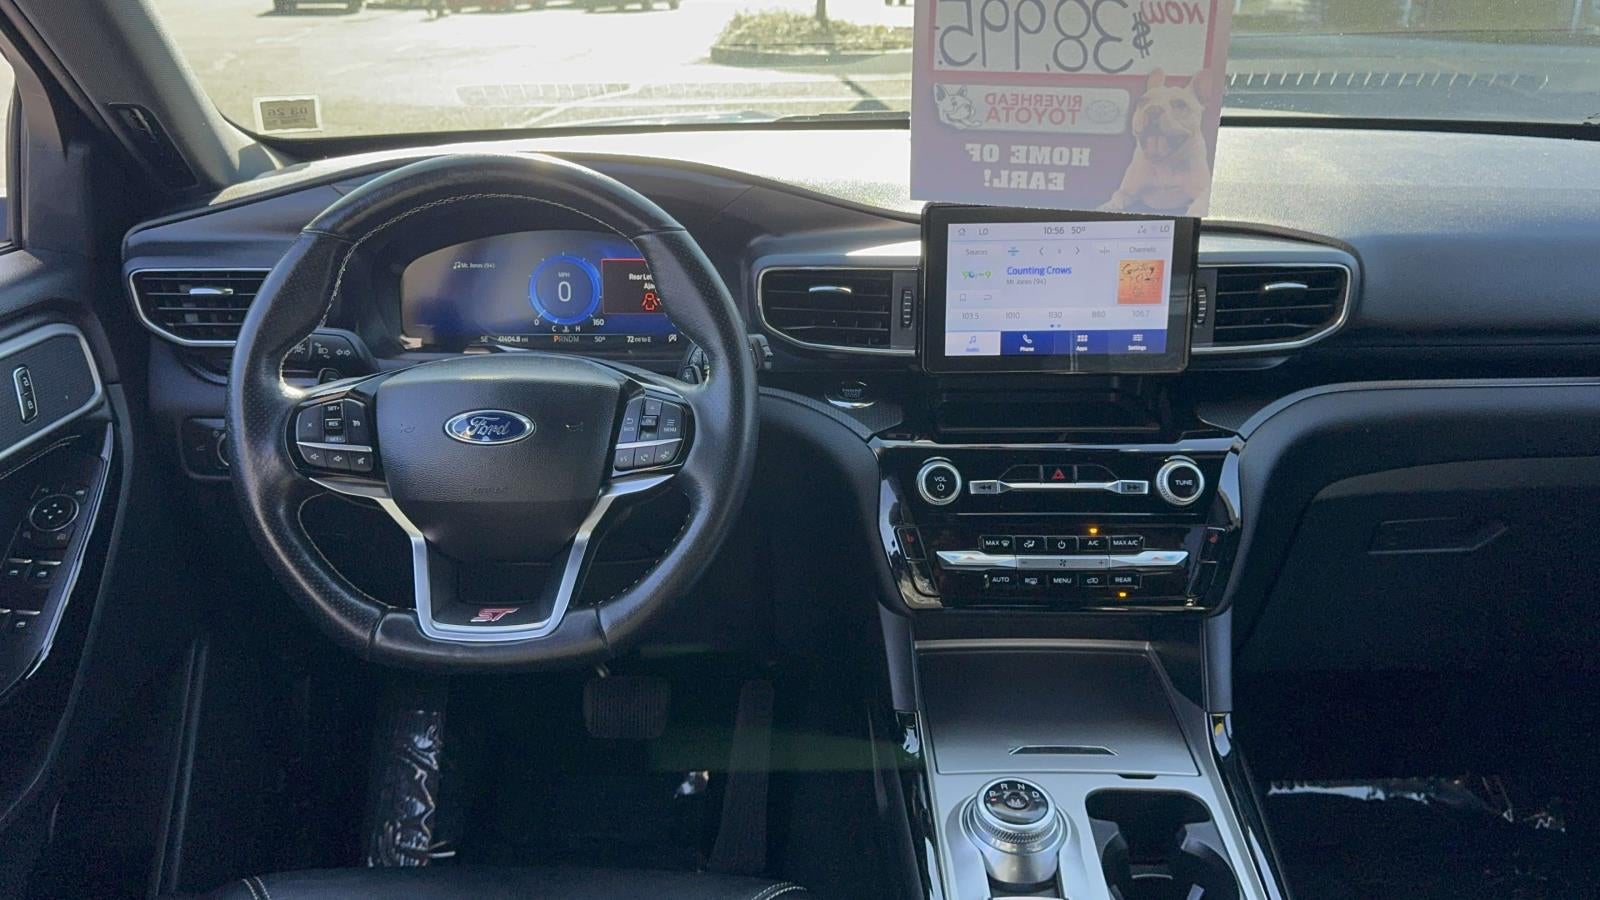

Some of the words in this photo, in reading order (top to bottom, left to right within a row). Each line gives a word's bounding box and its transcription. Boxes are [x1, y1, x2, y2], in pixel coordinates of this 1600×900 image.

[1044, 226, 1065, 235] 10:56
[1007, 266, 1046, 276] Counting
[1047, 266, 1072, 275] Crows
[558, 281, 572, 302] 0
[534, 318, 540, 326] 0
[592, 318, 605, 326] 160
[626, 335, 635, 343] 72
[1127, 344, 1147, 352] Settings
[464, 416, 511, 436] Ford
[470, 607, 520, 623] ST
